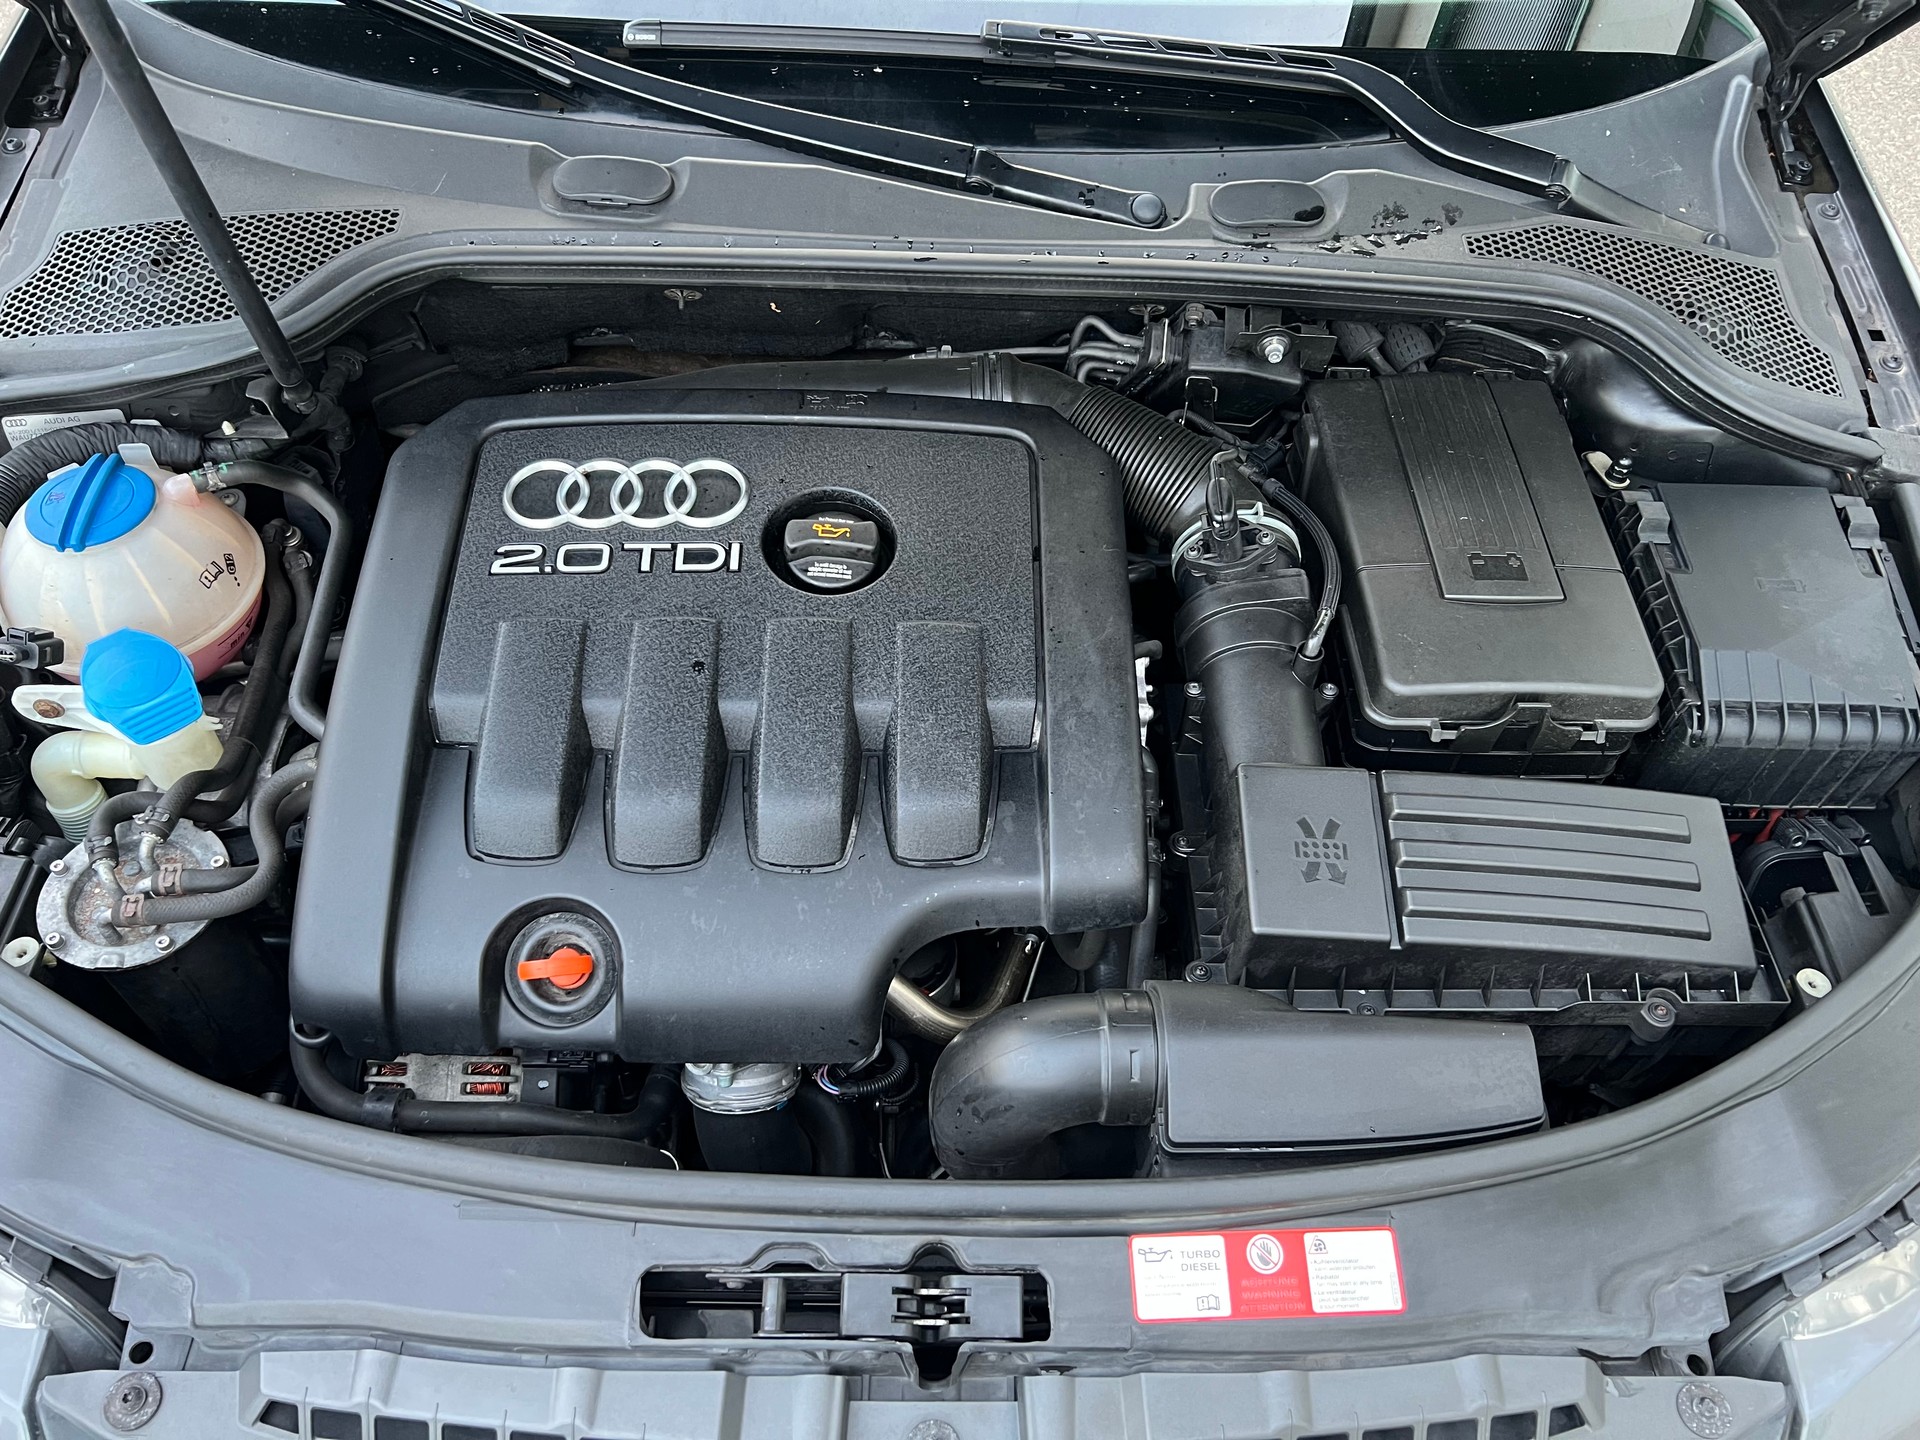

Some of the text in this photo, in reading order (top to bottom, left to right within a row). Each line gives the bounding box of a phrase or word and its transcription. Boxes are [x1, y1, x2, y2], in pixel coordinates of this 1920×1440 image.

[44, 417, 65, 425] AUDI
[490, 541, 743, 575] 2.0 TDI
[1180, 1249, 1221, 1259] TURBO
[1181, 1262, 1221, 1272] DIESEL
